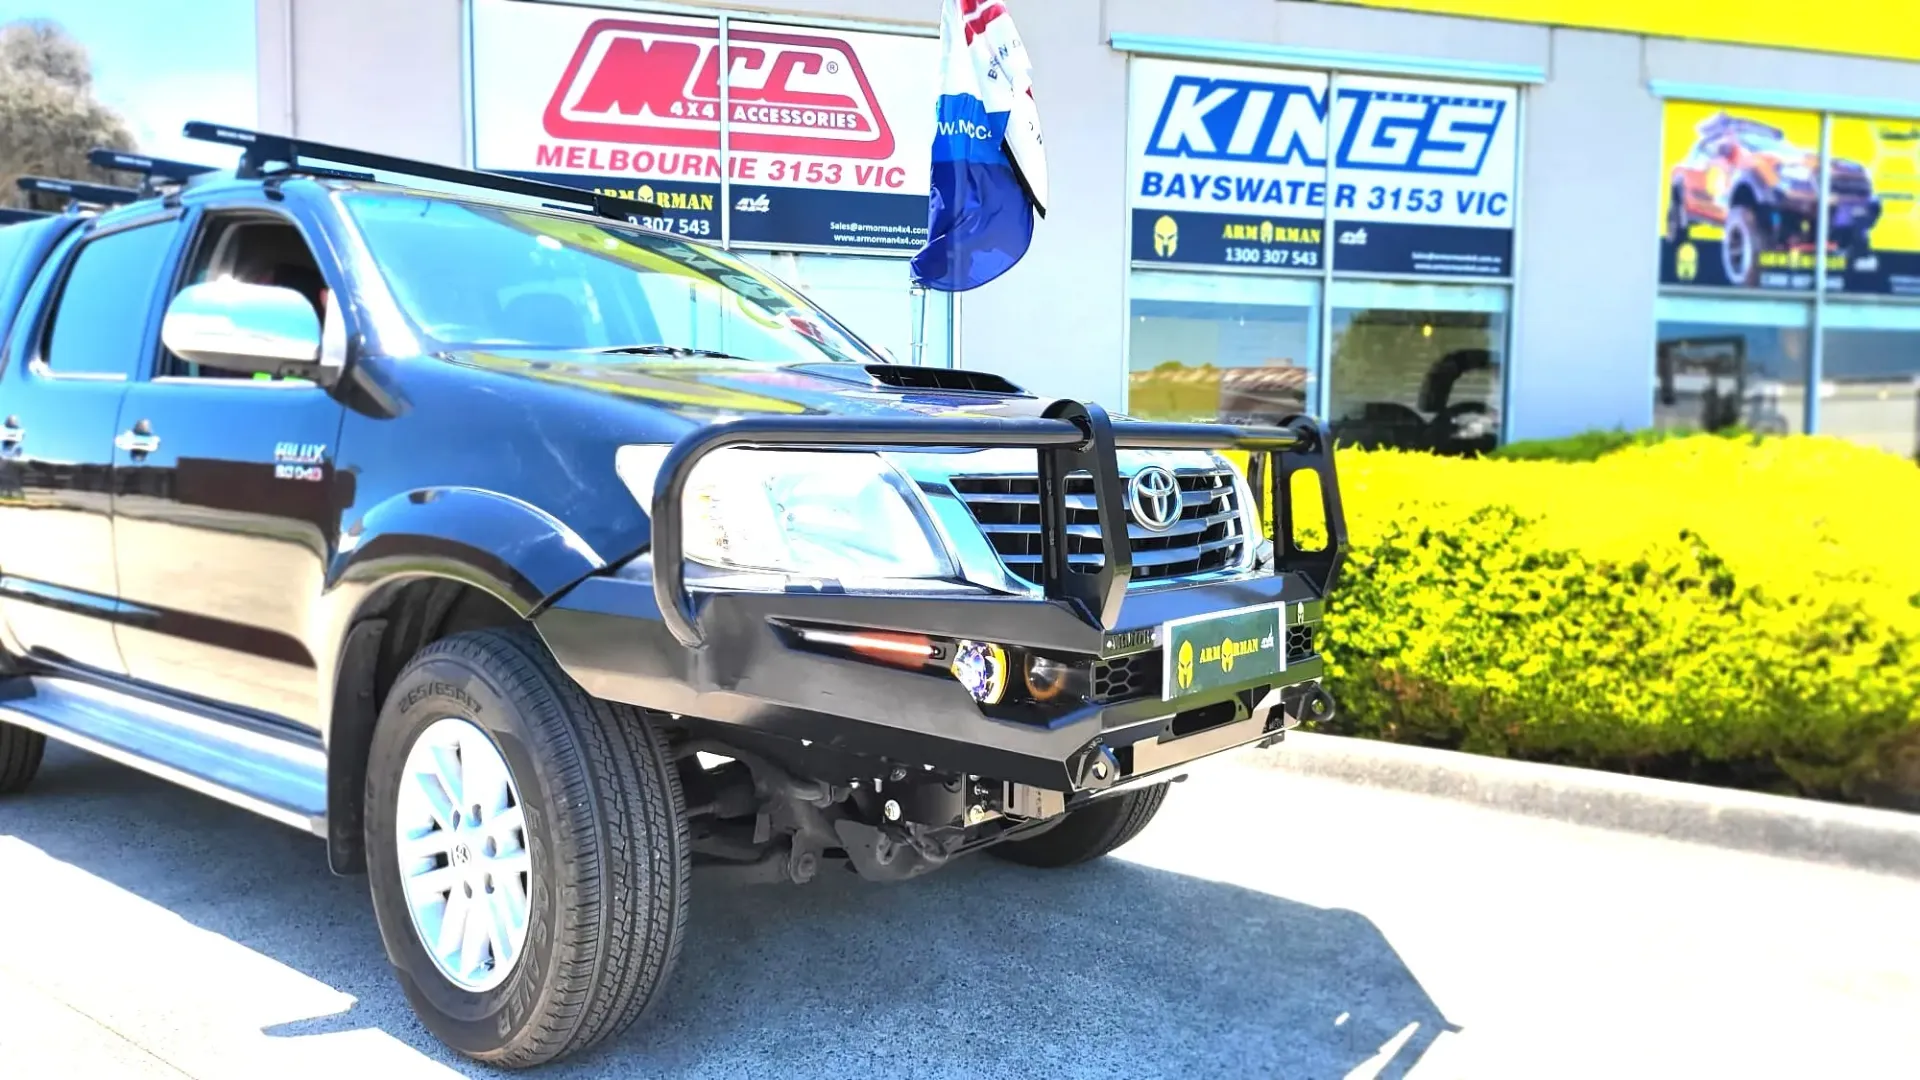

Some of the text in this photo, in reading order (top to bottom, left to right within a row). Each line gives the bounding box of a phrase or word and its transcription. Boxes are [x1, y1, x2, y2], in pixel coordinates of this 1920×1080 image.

[570, 36, 859, 115] MCC
[669, 102, 858, 129] 4X4 ACCESSORIES
[1152, 80, 1502, 172] KINGS
[535, 144, 907, 189] MELBOURNE 3153 VIC
[1140, 171, 1508, 216] BAYSWATER 3153 VIC
[678, 218, 711, 236] 543
[1225, 247, 1318, 266] 1300 307 543
